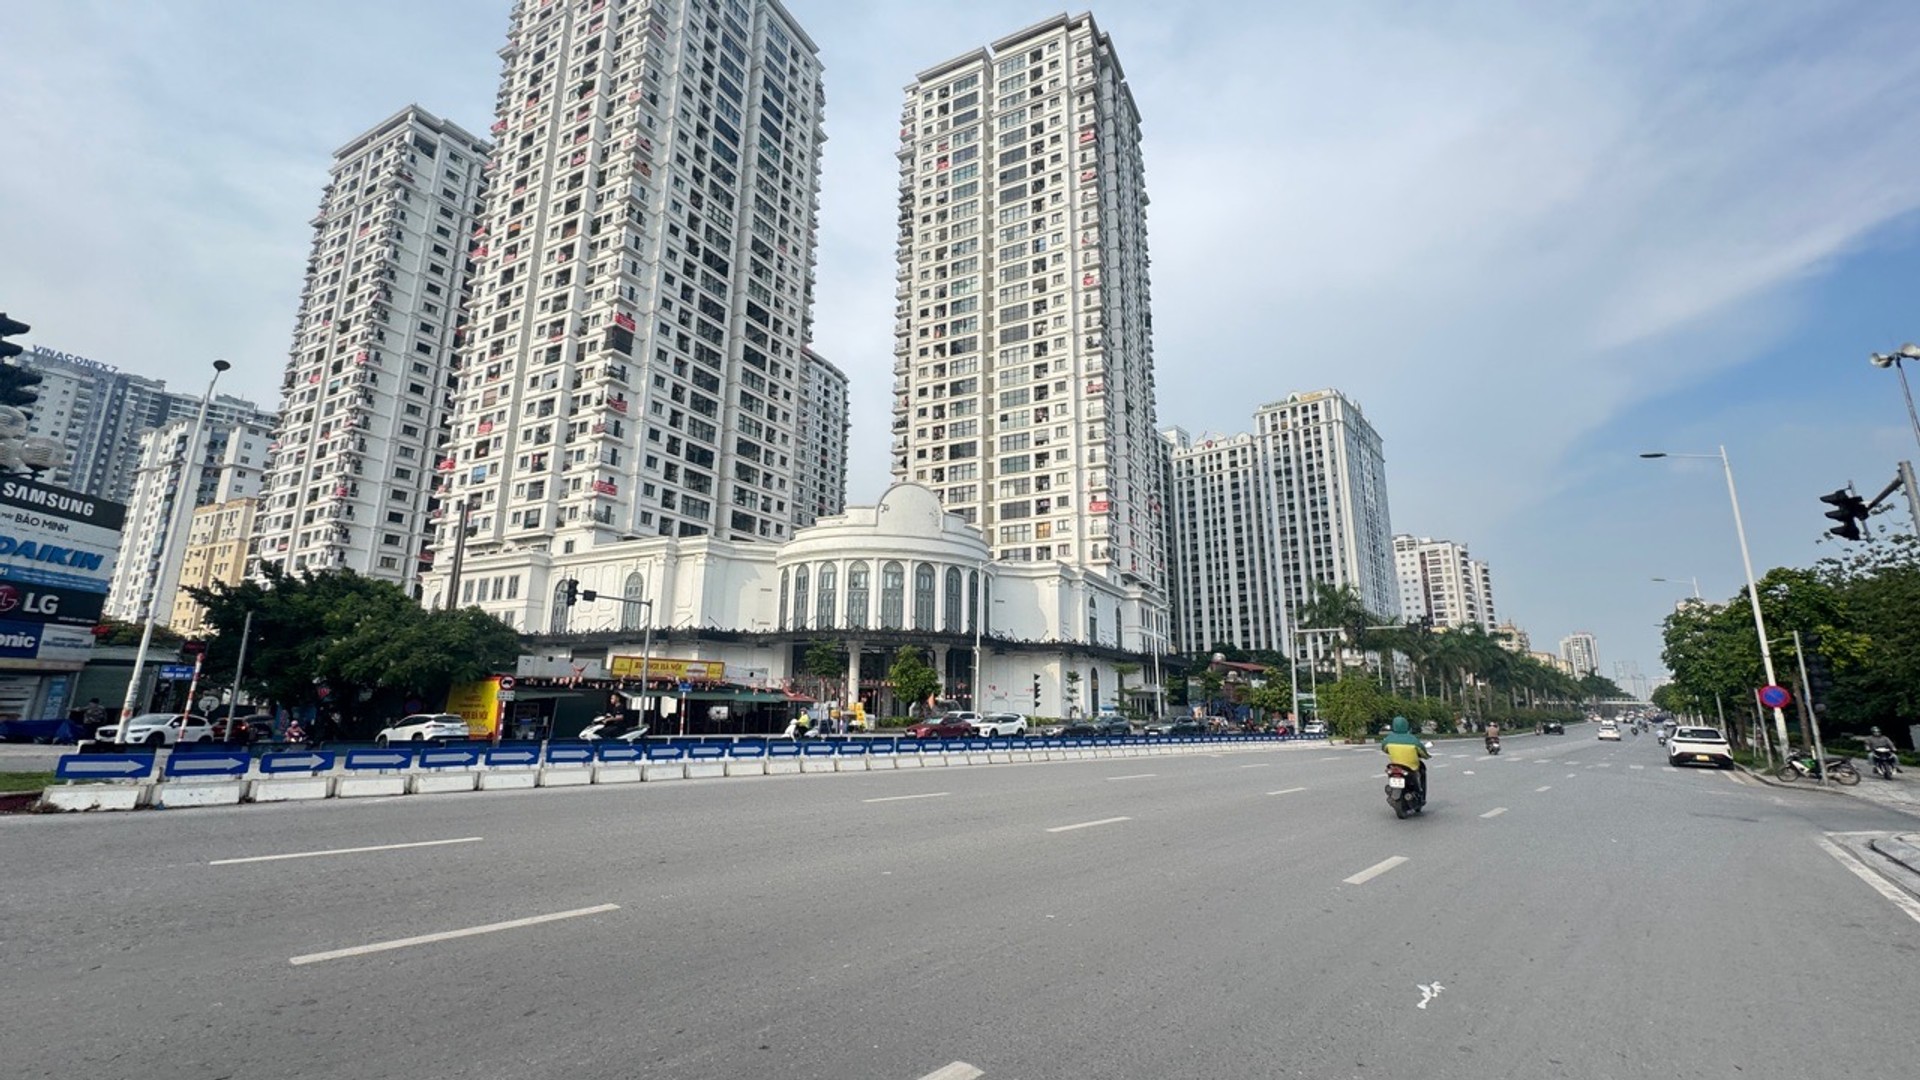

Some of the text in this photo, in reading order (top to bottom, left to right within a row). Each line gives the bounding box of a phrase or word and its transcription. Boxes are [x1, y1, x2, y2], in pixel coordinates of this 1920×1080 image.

[33, 345, 109, 372] VINACONEX
[3, 482, 94, 516] SAMSUNG
[15, 513, 40, 527] BẢO
[42, 519, 69, 533] MINH
[0, 535, 104, 571] DAIKIN
[23, 593, 59, 615] LG
